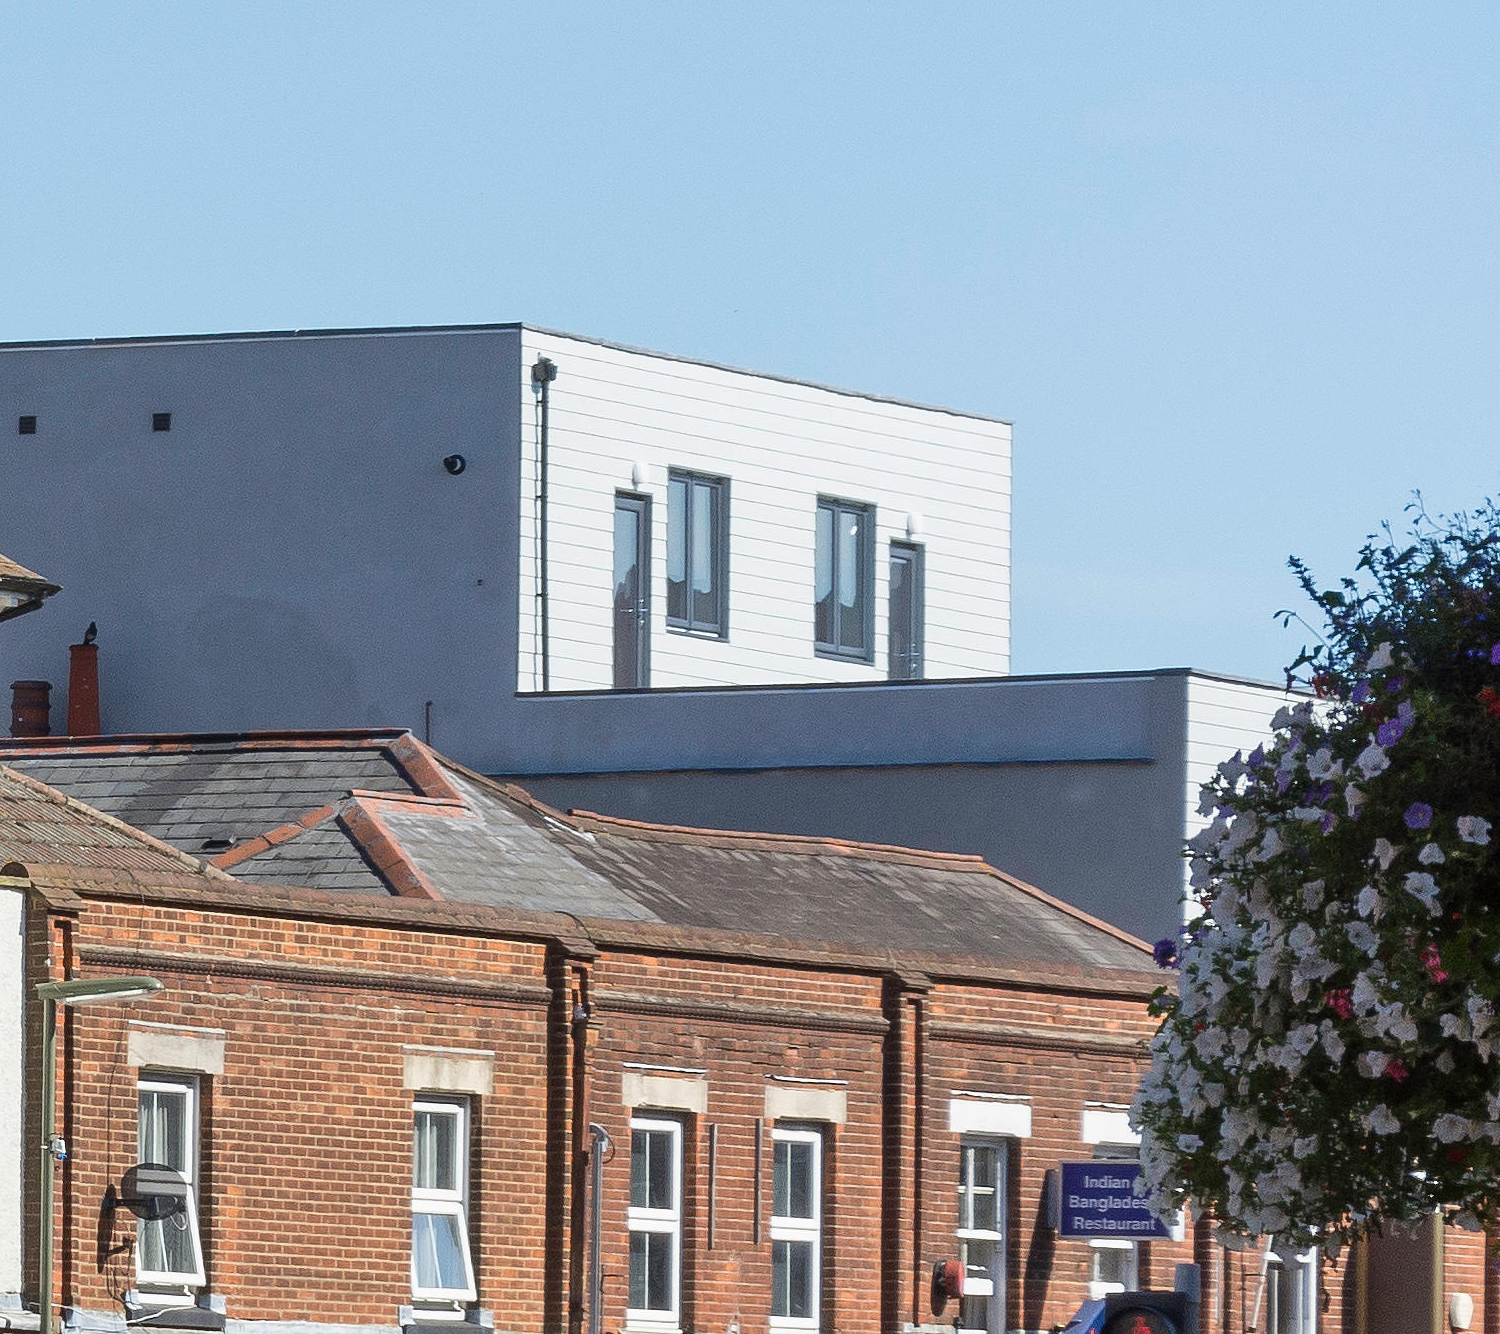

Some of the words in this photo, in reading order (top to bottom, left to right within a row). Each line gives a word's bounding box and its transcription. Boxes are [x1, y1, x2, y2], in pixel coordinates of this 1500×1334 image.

[1084, 1175, 1130, 1188] Indian
[1068, 1194, 1148, 1212] Banglades
[1074, 1216, 1157, 1230] Restaurant
